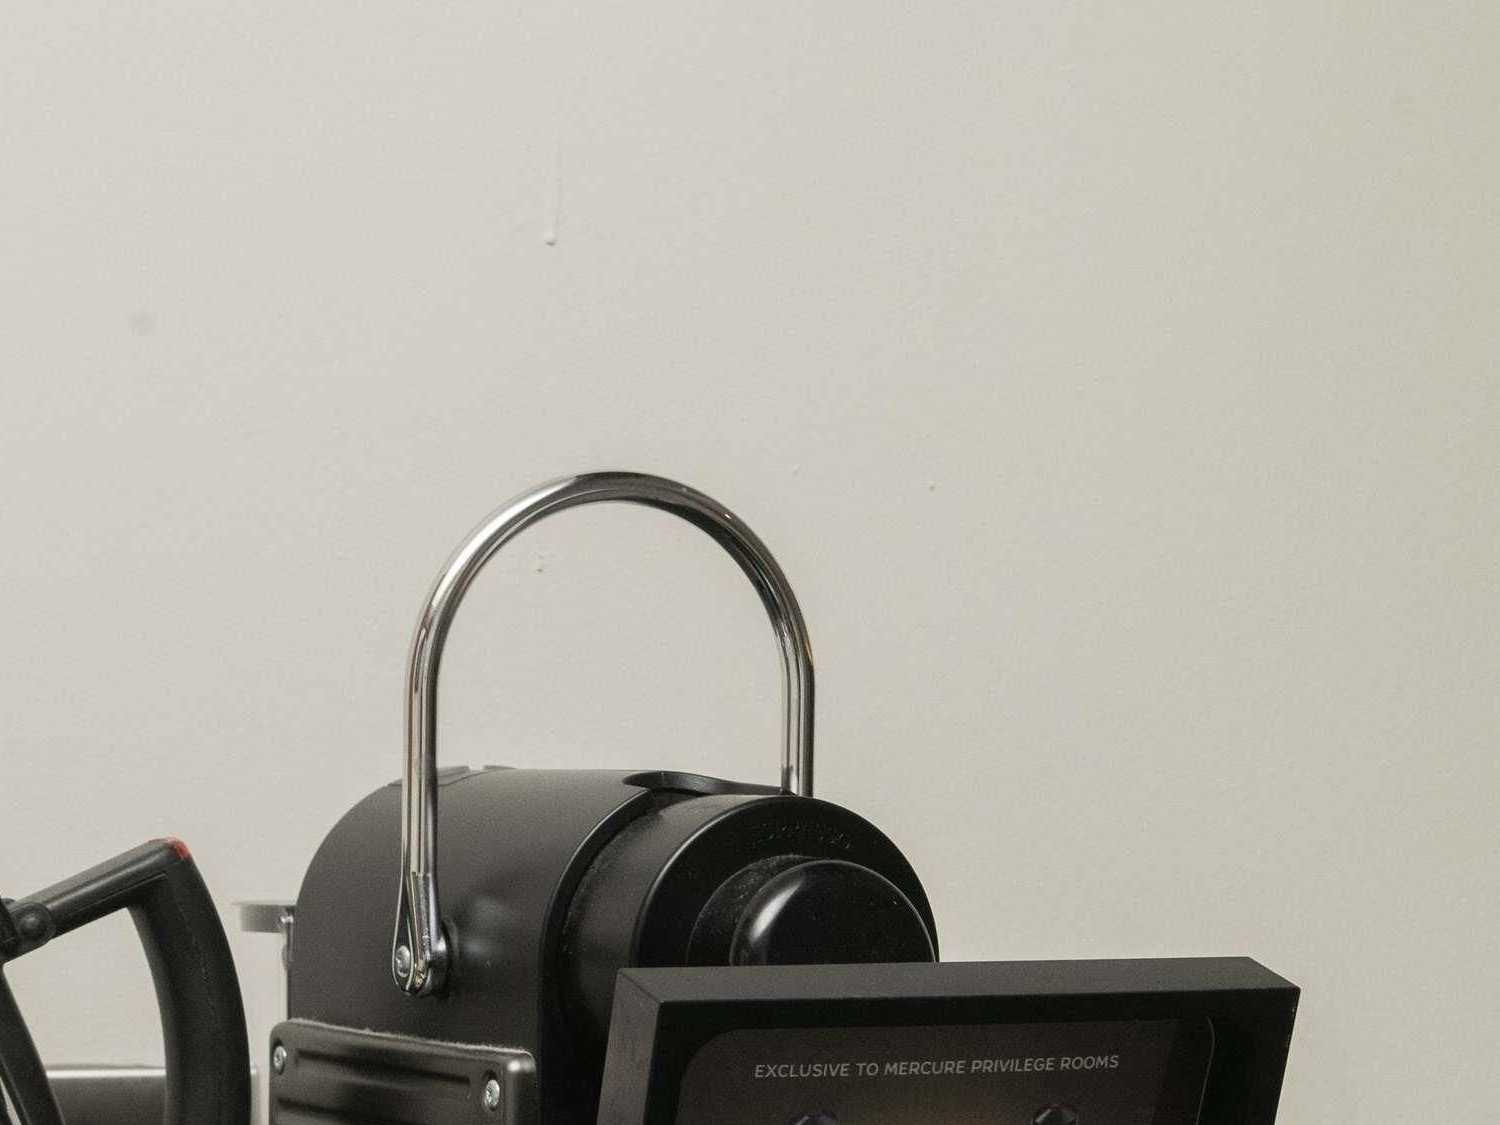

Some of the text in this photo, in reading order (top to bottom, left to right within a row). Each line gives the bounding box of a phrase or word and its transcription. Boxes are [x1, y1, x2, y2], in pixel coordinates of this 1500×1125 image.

[754, 1055, 1120, 1079] EXCLUSIVE TO MERCURE PRIVILEGE ROOMS
